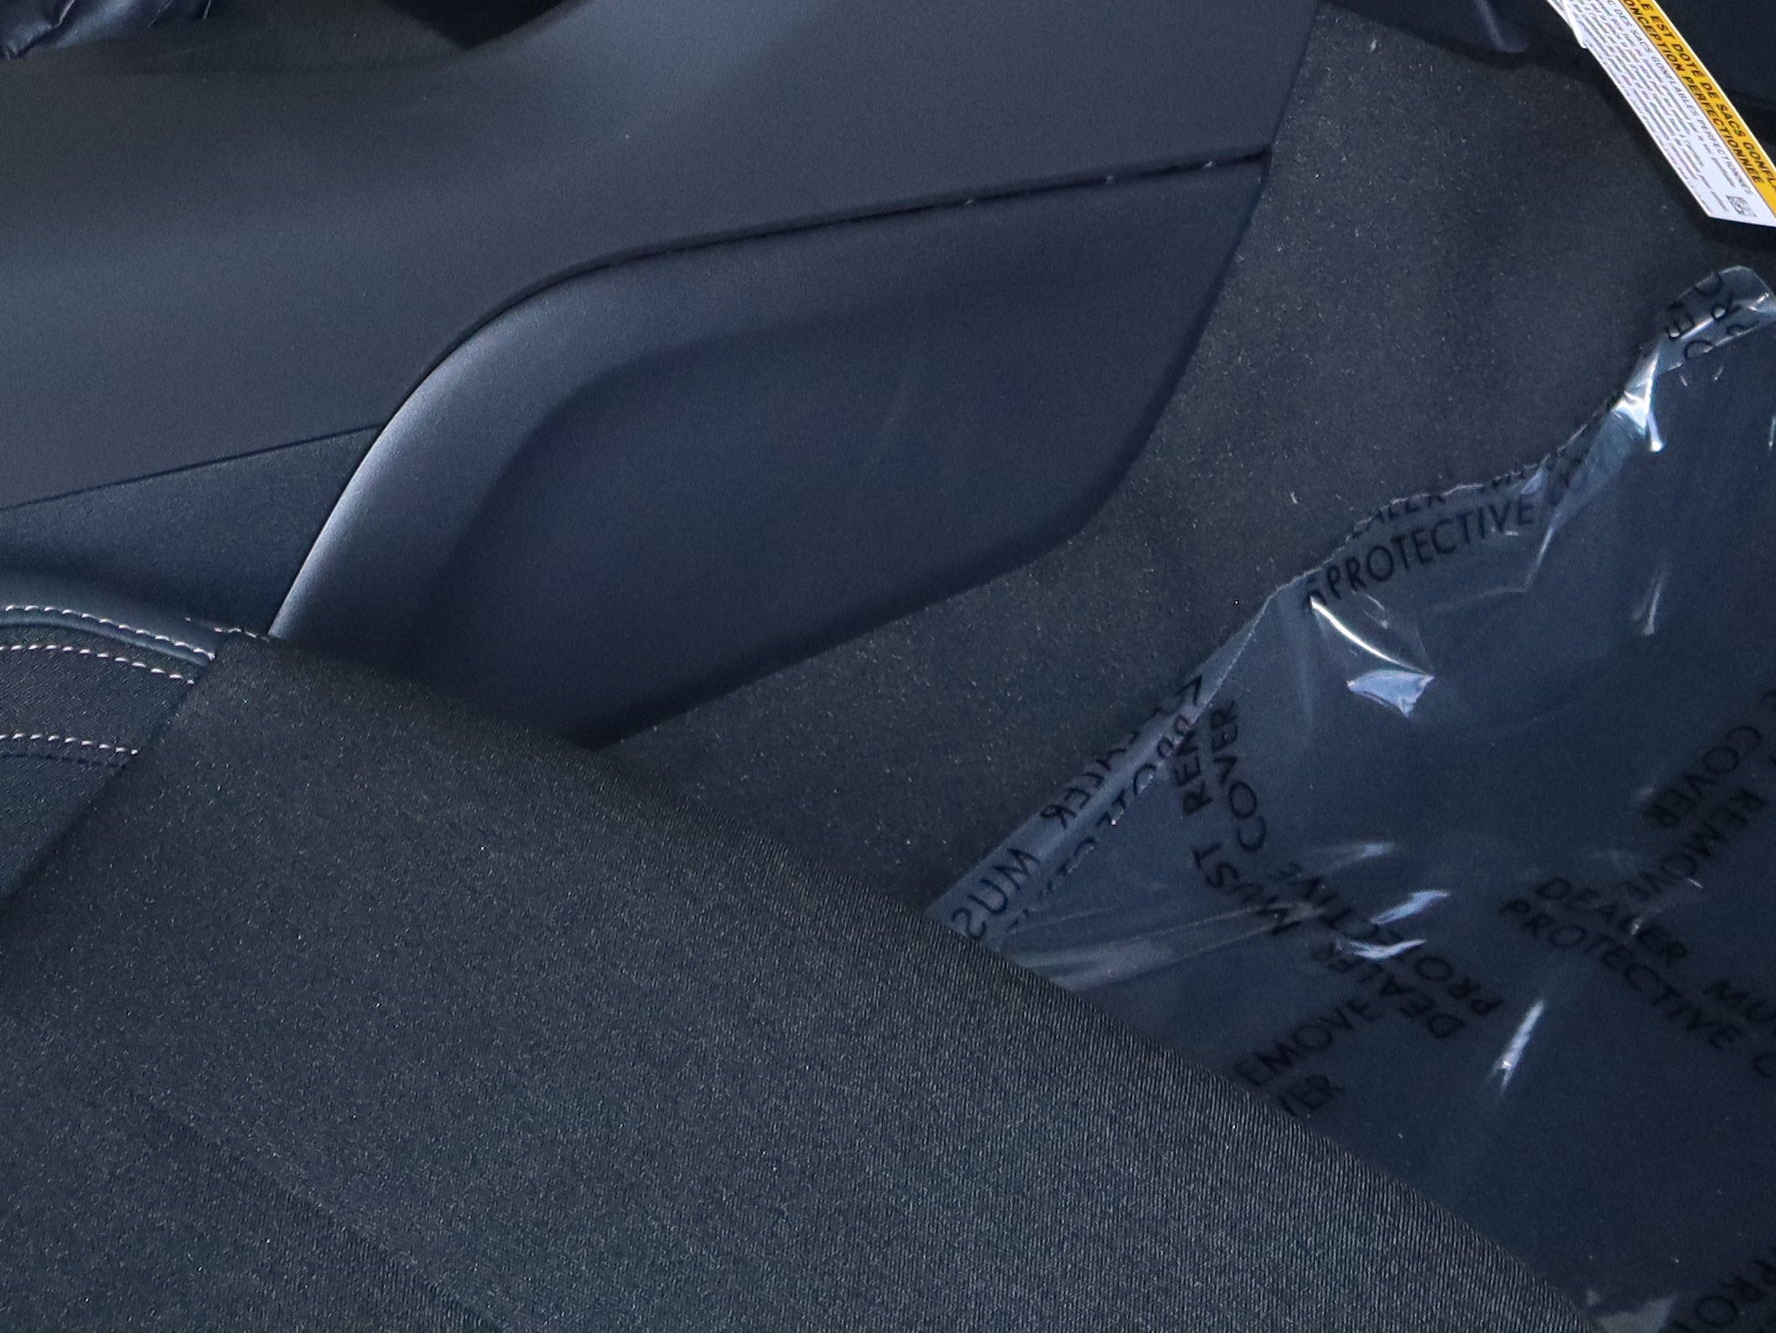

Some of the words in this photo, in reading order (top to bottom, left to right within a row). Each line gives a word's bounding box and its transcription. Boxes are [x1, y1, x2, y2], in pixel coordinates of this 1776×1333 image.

[1615, 10, 1632, 26] DES
[1631, 29, 1652, 54] SACS
[1651, 57, 1699, 118] GONFLABLES
[1649, 16, 1675, 39] EST
[1700, 84, 1720, 100] DE
[1714, 104, 1747, 138] SACS
[1323, 489, 1535, 603] PROTECTIVE
[1210, 699, 1269, 853] COVER
[1643, 724, 1761, 828] COVER
[1190, 849, 1302, 938] MUST
[1619, 789, 1771, 906] REMOVE
[1486, 891, 1760, 1055] PROTECTIVE
[1530, 870, 1701, 970] DEALER
[1233, 996, 1382, 1088] EMOVE
[1309, 942, 1469, 1040] DEALER
